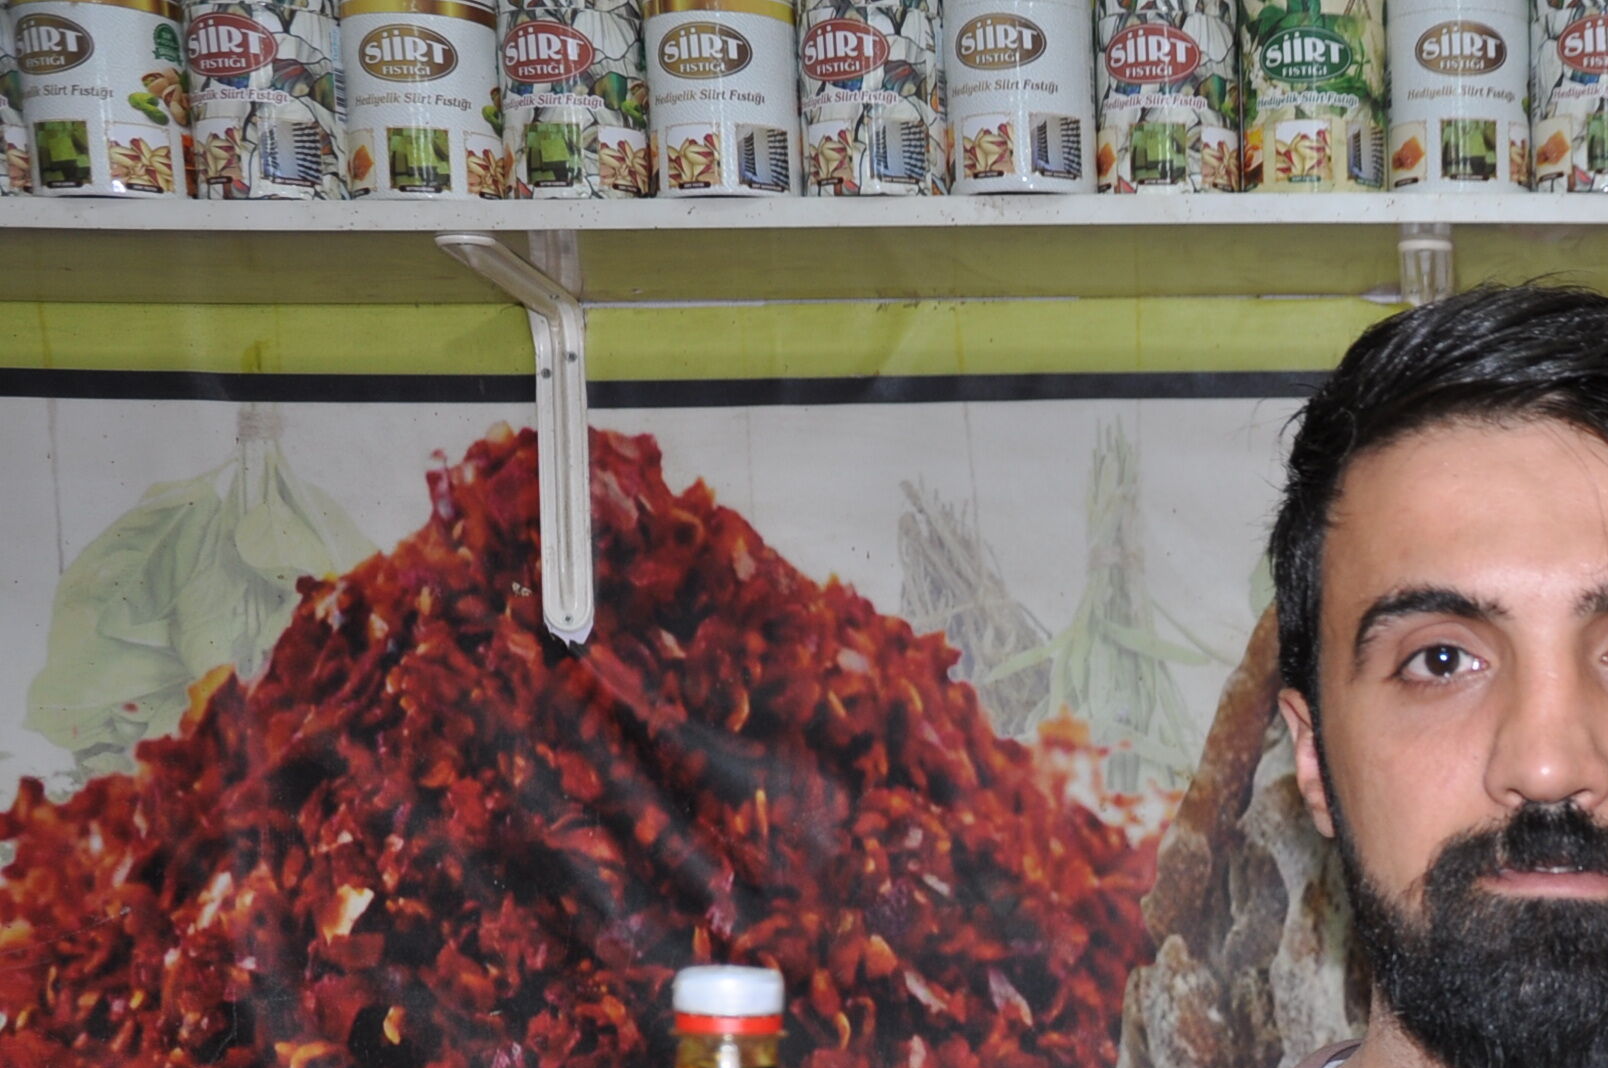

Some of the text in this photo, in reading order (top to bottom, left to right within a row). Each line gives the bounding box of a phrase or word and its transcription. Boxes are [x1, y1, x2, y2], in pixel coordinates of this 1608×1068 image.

[994, 79, 1019, 91] Siirt
[221, 89, 245, 100] Siirt
[404, 93, 432, 105] Siirt
[537, 94, 562, 106] Siirt
[700, 89, 726, 101] Siirt
[835, 90, 859, 102] Siirt
